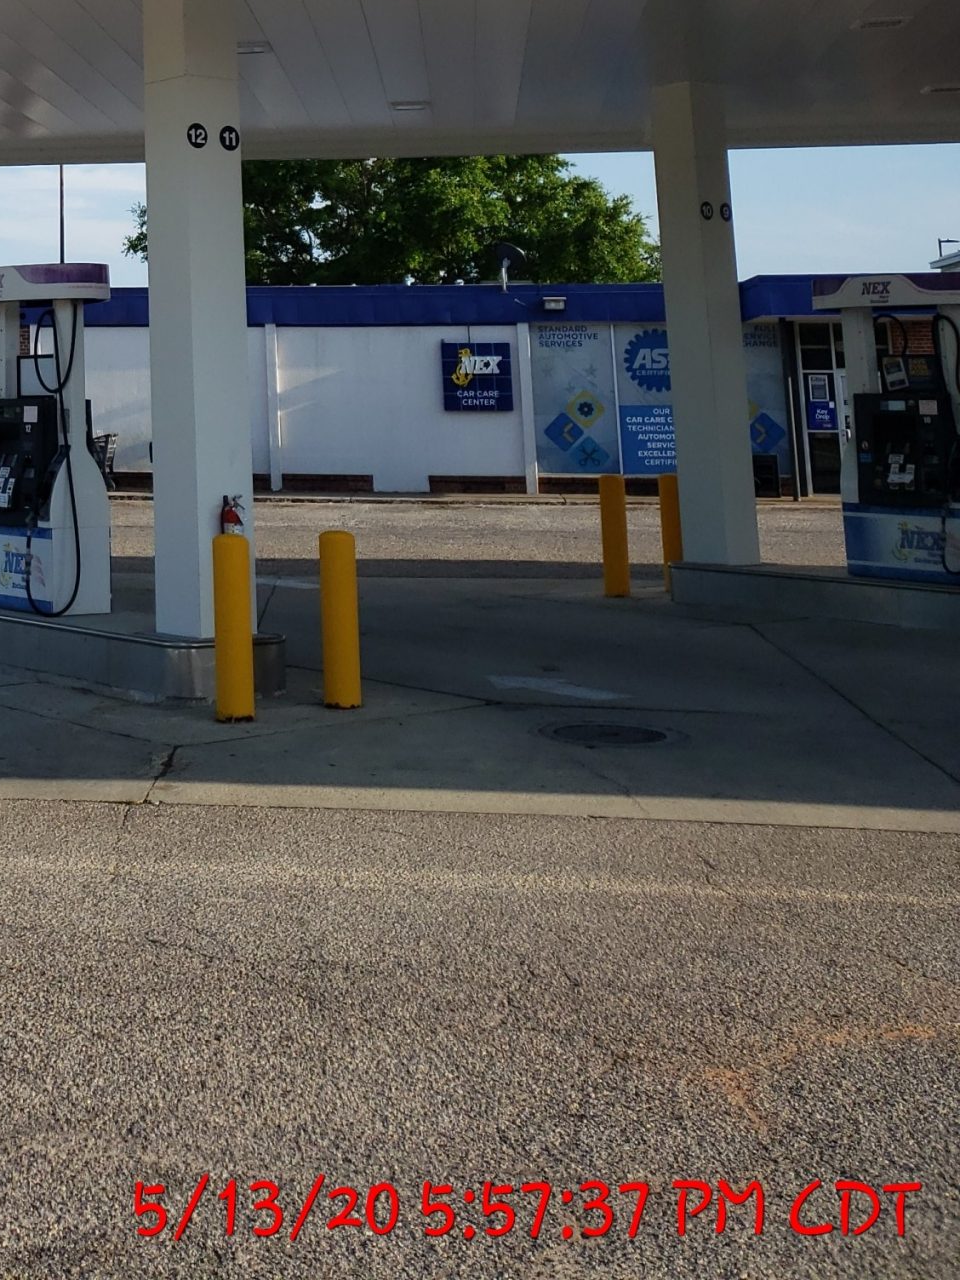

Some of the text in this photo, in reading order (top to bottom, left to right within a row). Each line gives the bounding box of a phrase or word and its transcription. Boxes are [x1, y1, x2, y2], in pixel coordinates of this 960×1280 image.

[188, 128, 206, 144] 12
[223, 131, 236, 146] 11
[861, 281, 891, 295] NEX
[537, 325, 588, 333] STANDARD
[539, 340, 583, 348] SERVICES
[460, 355, 502, 374] NEX
[632, 348, 670, 369] AS
